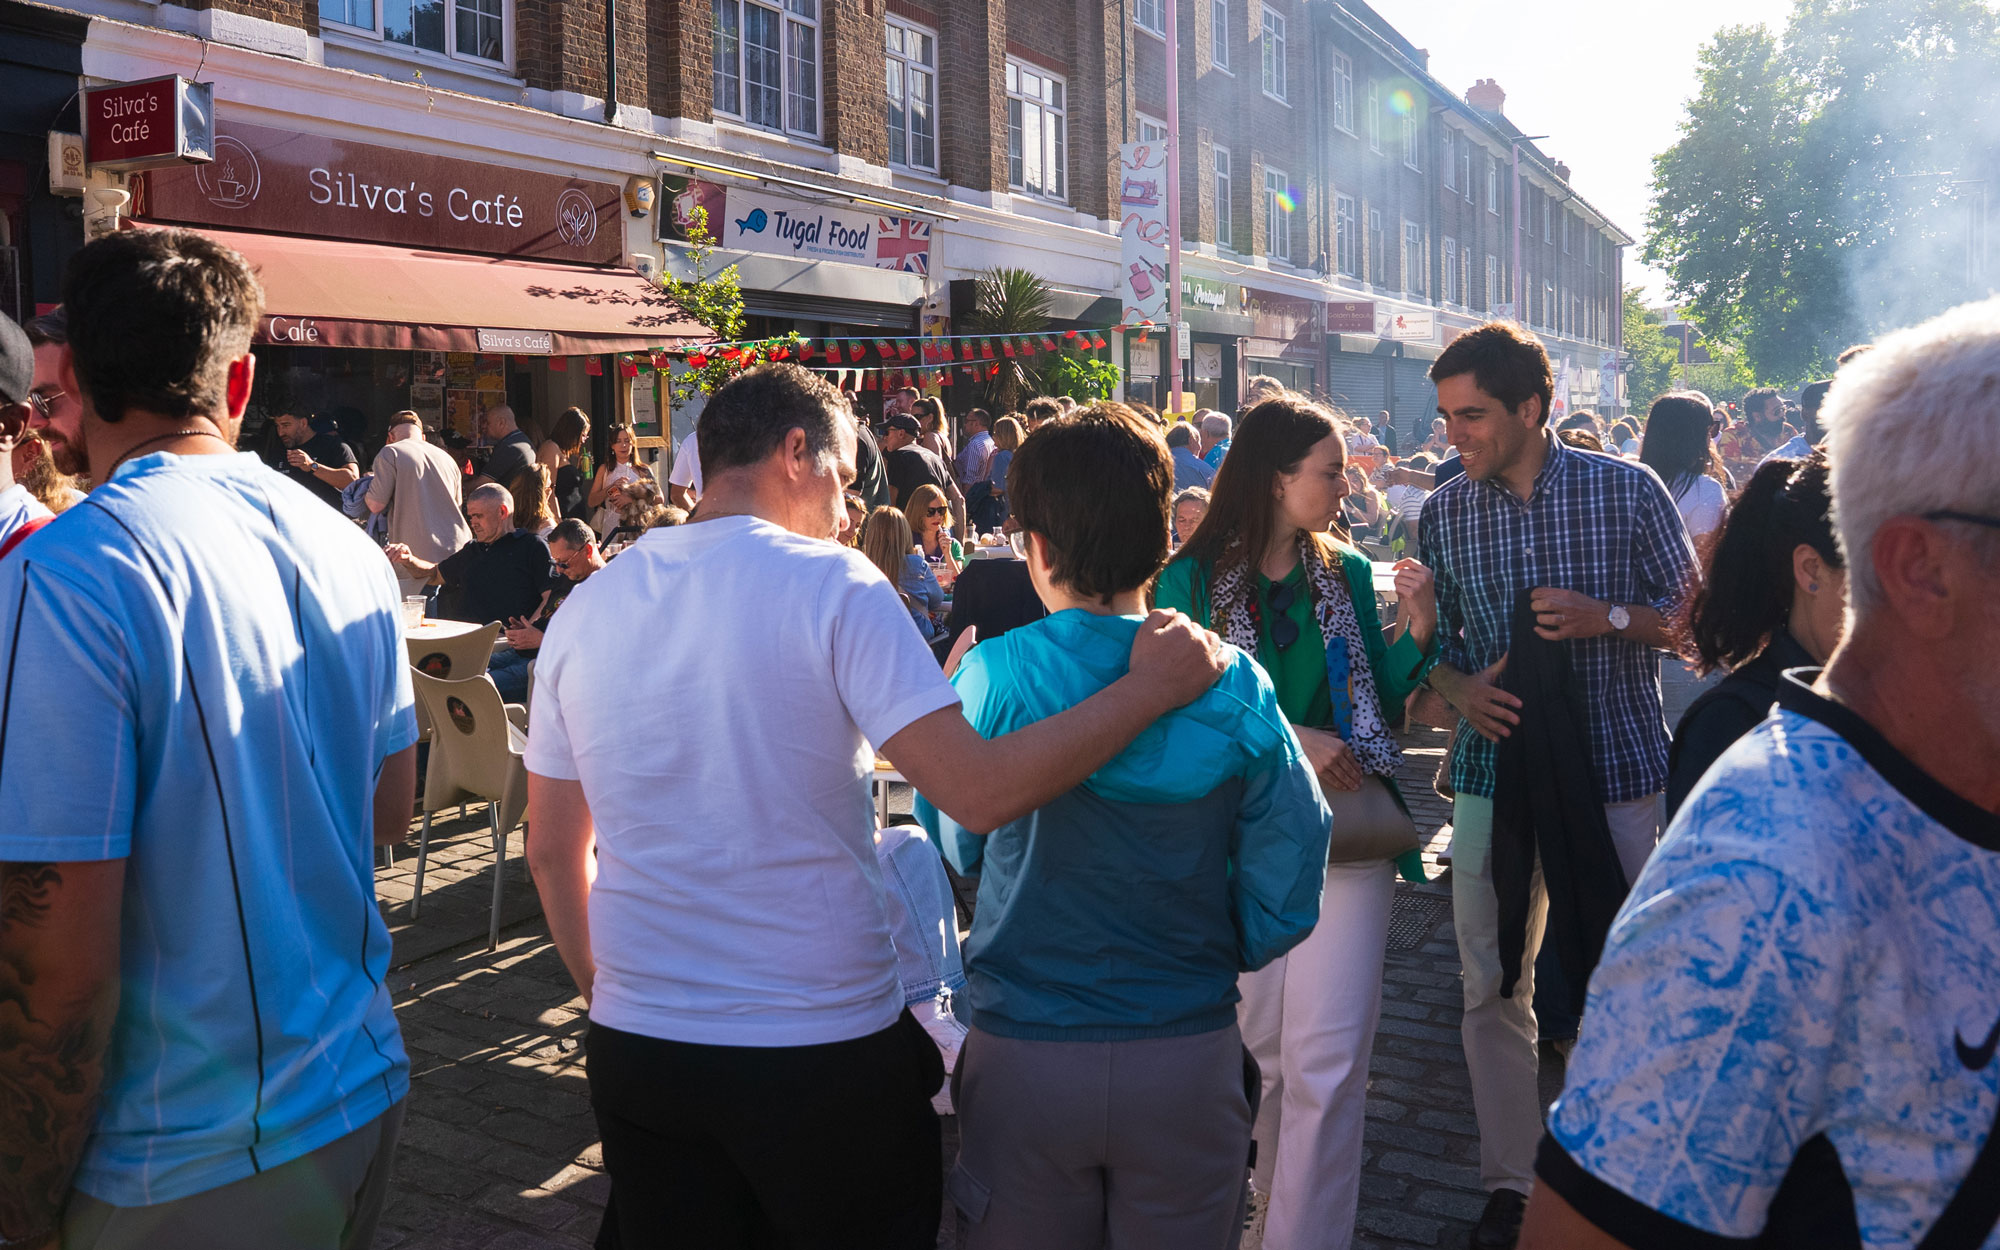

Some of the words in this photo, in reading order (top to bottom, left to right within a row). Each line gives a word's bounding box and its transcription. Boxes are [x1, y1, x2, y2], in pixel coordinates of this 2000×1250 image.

[103, 92, 158, 119] Silva's
[111, 119, 150, 144] Café
[309, 167, 434, 217] Silva's
[447, 187, 524, 228] Café
[774, 211, 823, 250] Tugal
[828, 220, 870, 250] Food
[1193, 284, 1226, 312] Portugal
[270, 316, 318, 342] Café
[1352, 312, 1373, 320] Beauty
[482, 334, 521, 348] Silva's
[523, 336, 550, 349] Café
